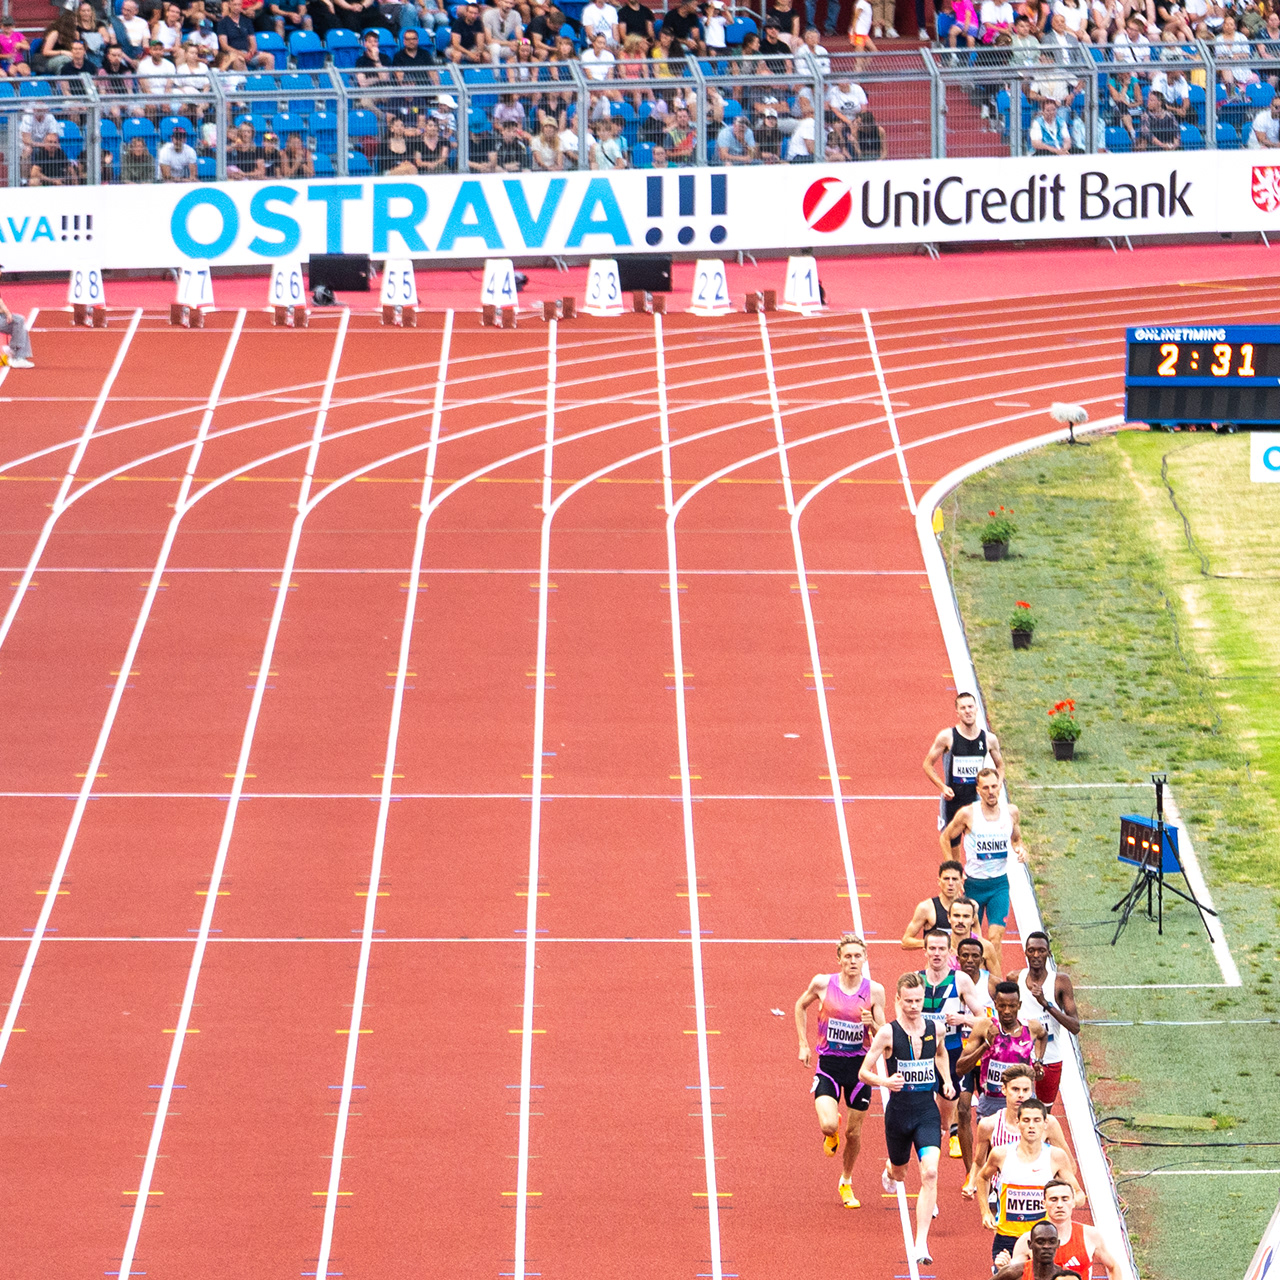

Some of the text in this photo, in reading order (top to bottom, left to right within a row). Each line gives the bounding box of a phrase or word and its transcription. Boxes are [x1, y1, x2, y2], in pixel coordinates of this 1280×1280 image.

[170, 173, 728, 260] OSTRAVA!!!
[861, 169, 1195, 228] UniCredit Bank
[977, 839, 1008, 852] SASÍNEK
[828, 1027, 864, 1042] THOMAS
